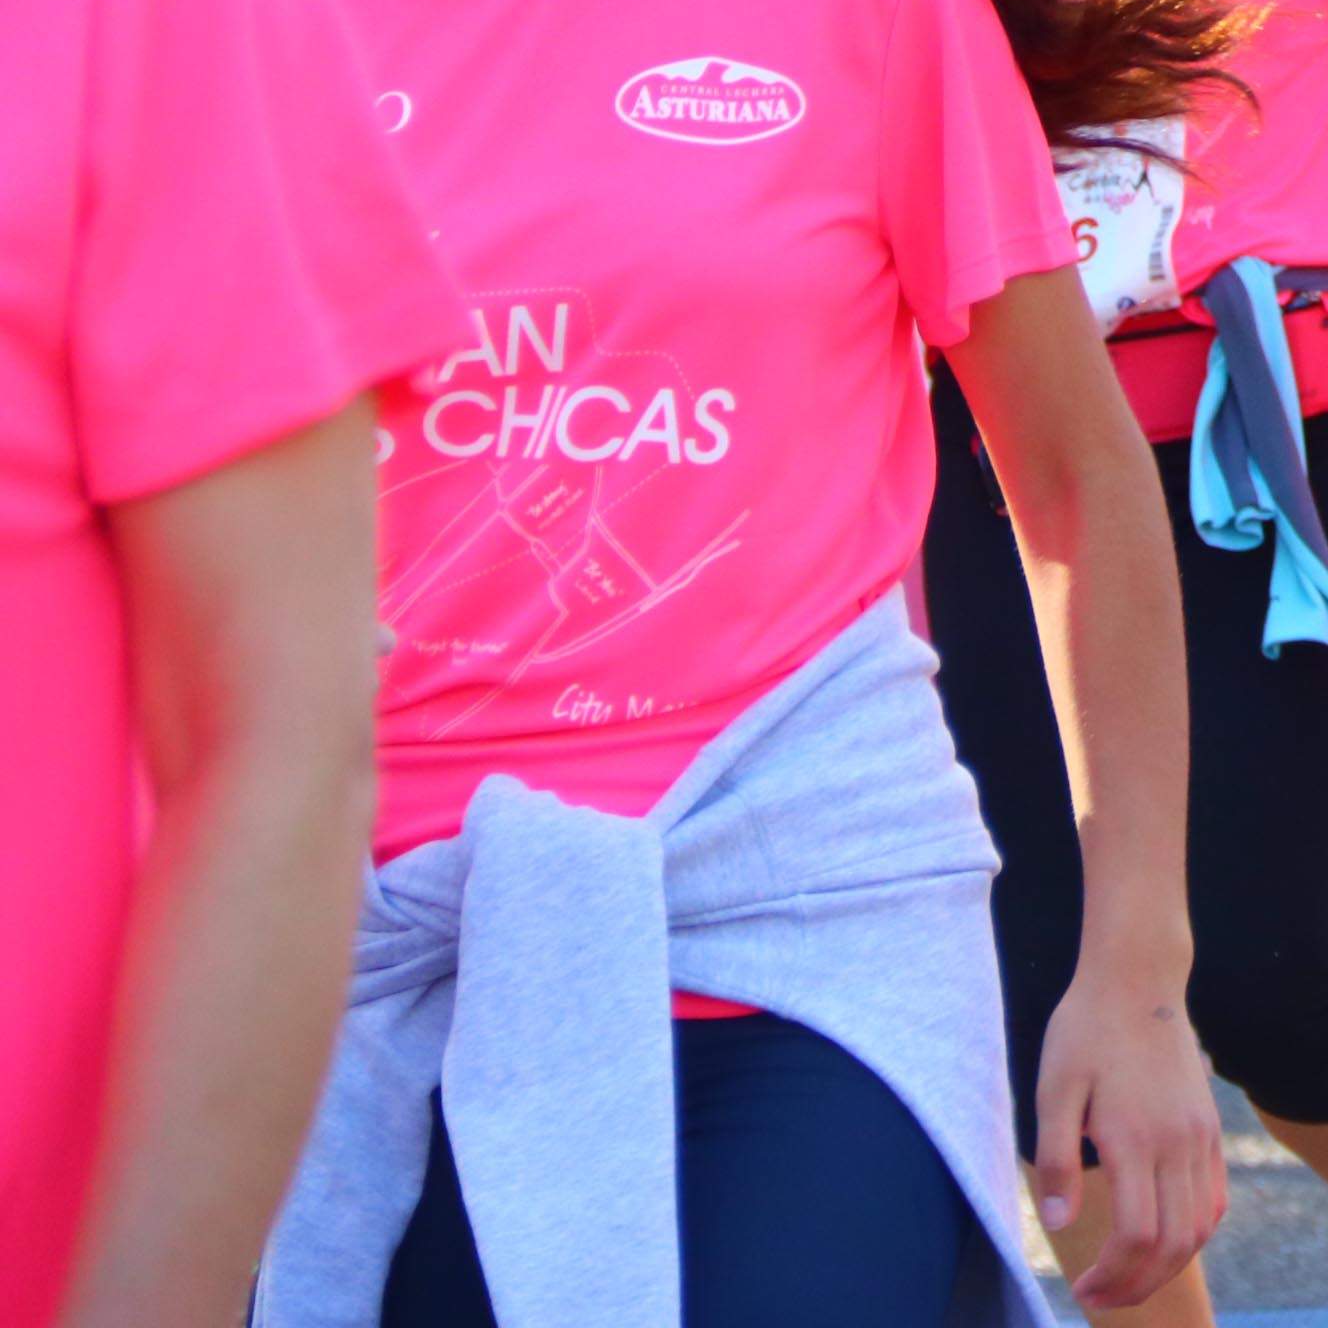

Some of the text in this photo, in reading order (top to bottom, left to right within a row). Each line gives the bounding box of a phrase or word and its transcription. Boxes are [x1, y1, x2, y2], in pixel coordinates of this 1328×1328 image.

[631, 84, 792, 123] ASTURIANA
[661, 84, 720, 97] CENTRAL
[423, 385, 736, 465] CHICAS
